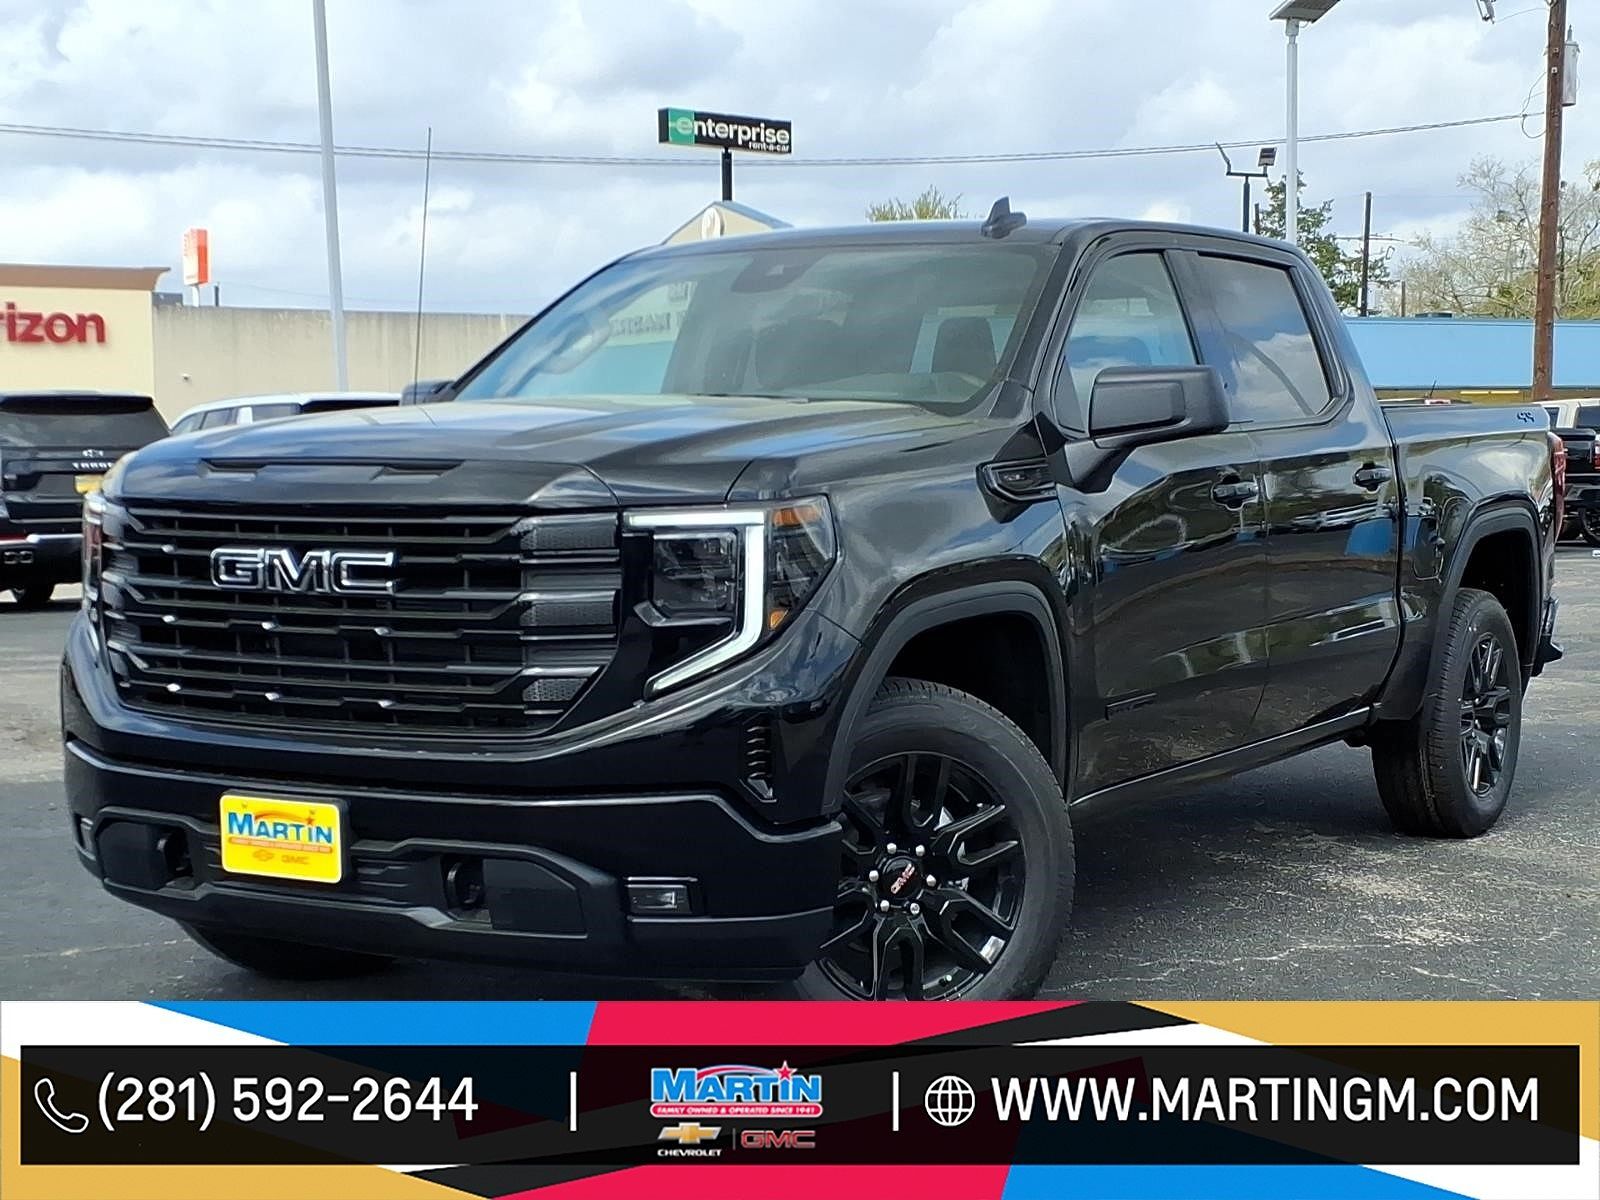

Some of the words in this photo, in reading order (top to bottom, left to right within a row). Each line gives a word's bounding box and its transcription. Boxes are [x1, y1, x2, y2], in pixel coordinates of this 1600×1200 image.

[675, 117, 790, 145] enterprise
[0, 301, 106, 343] izon
[210, 547, 395, 595] GMC
